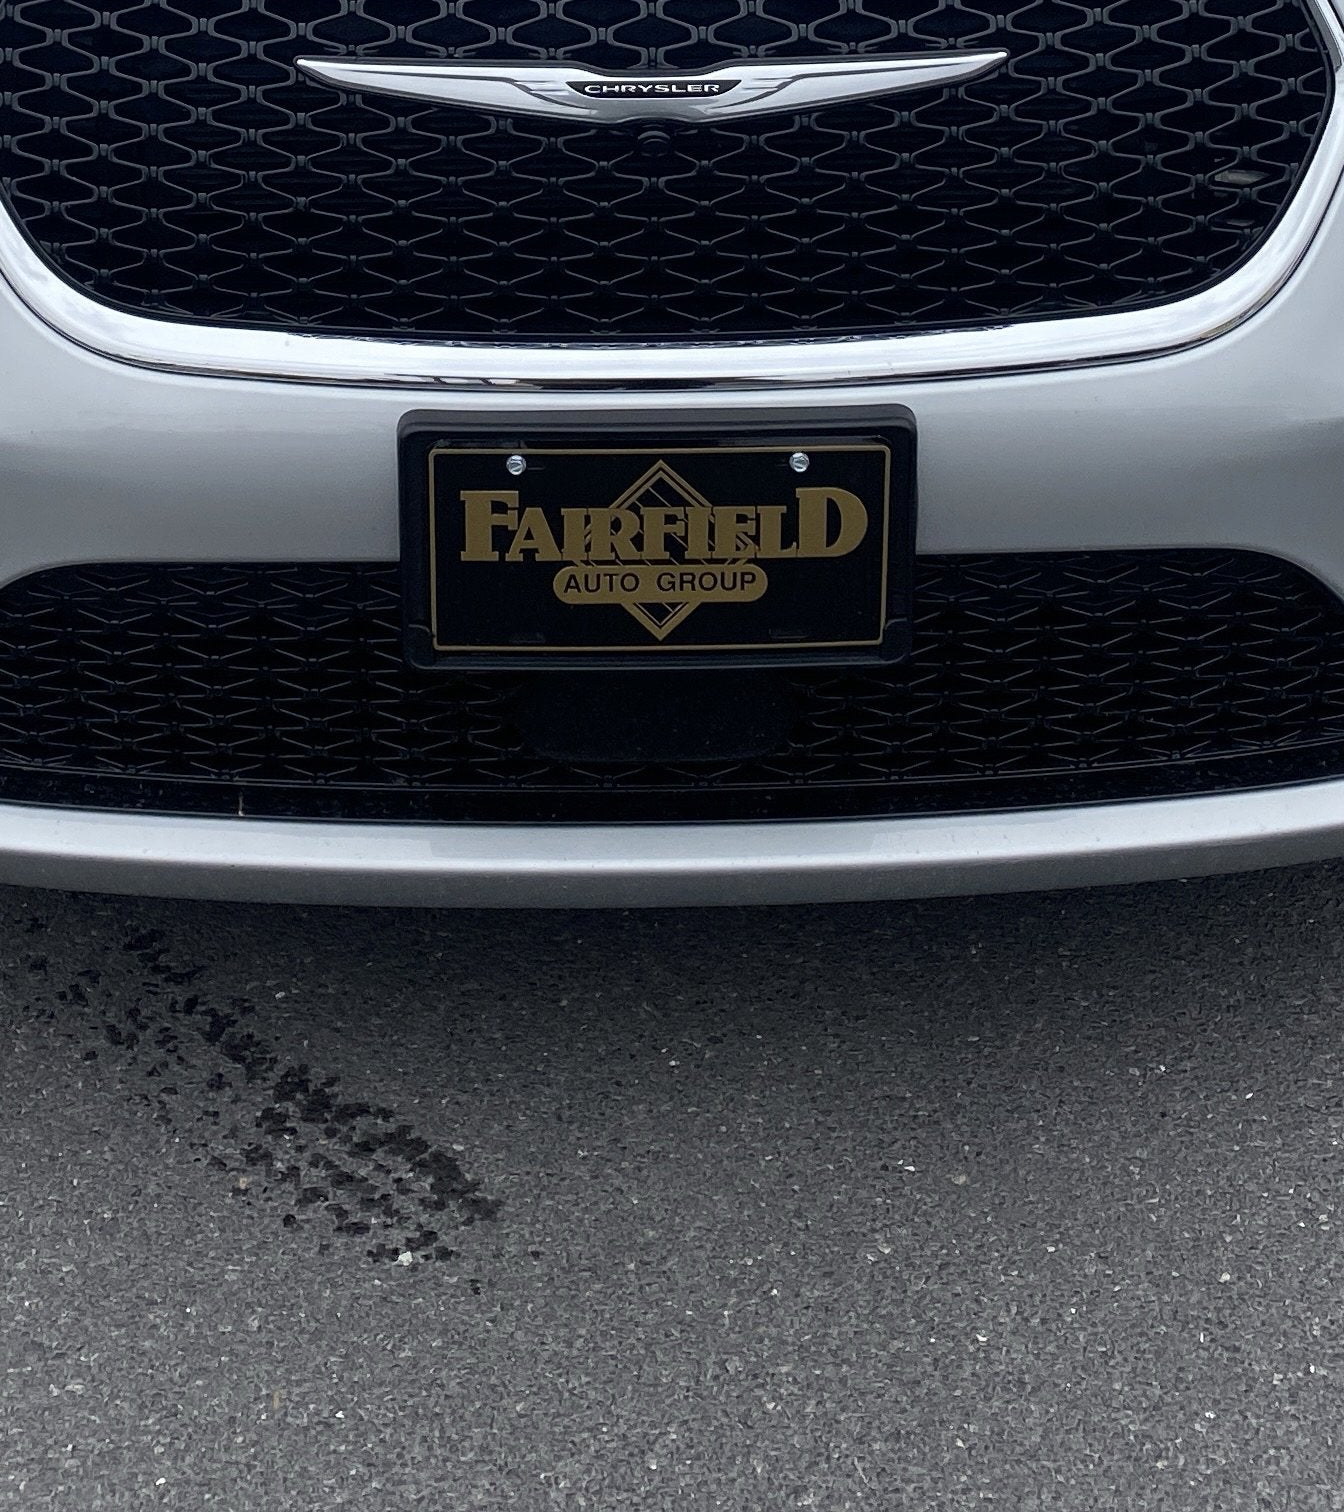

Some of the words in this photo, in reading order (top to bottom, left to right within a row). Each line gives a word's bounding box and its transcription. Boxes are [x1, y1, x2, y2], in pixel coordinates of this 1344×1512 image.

[584, 83, 720, 94] CHRYSLER
[459, 486, 869, 562] FAIRFIELD
[563, 572, 640, 594] AUTO
[657, 570, 757, 593] GROUP
